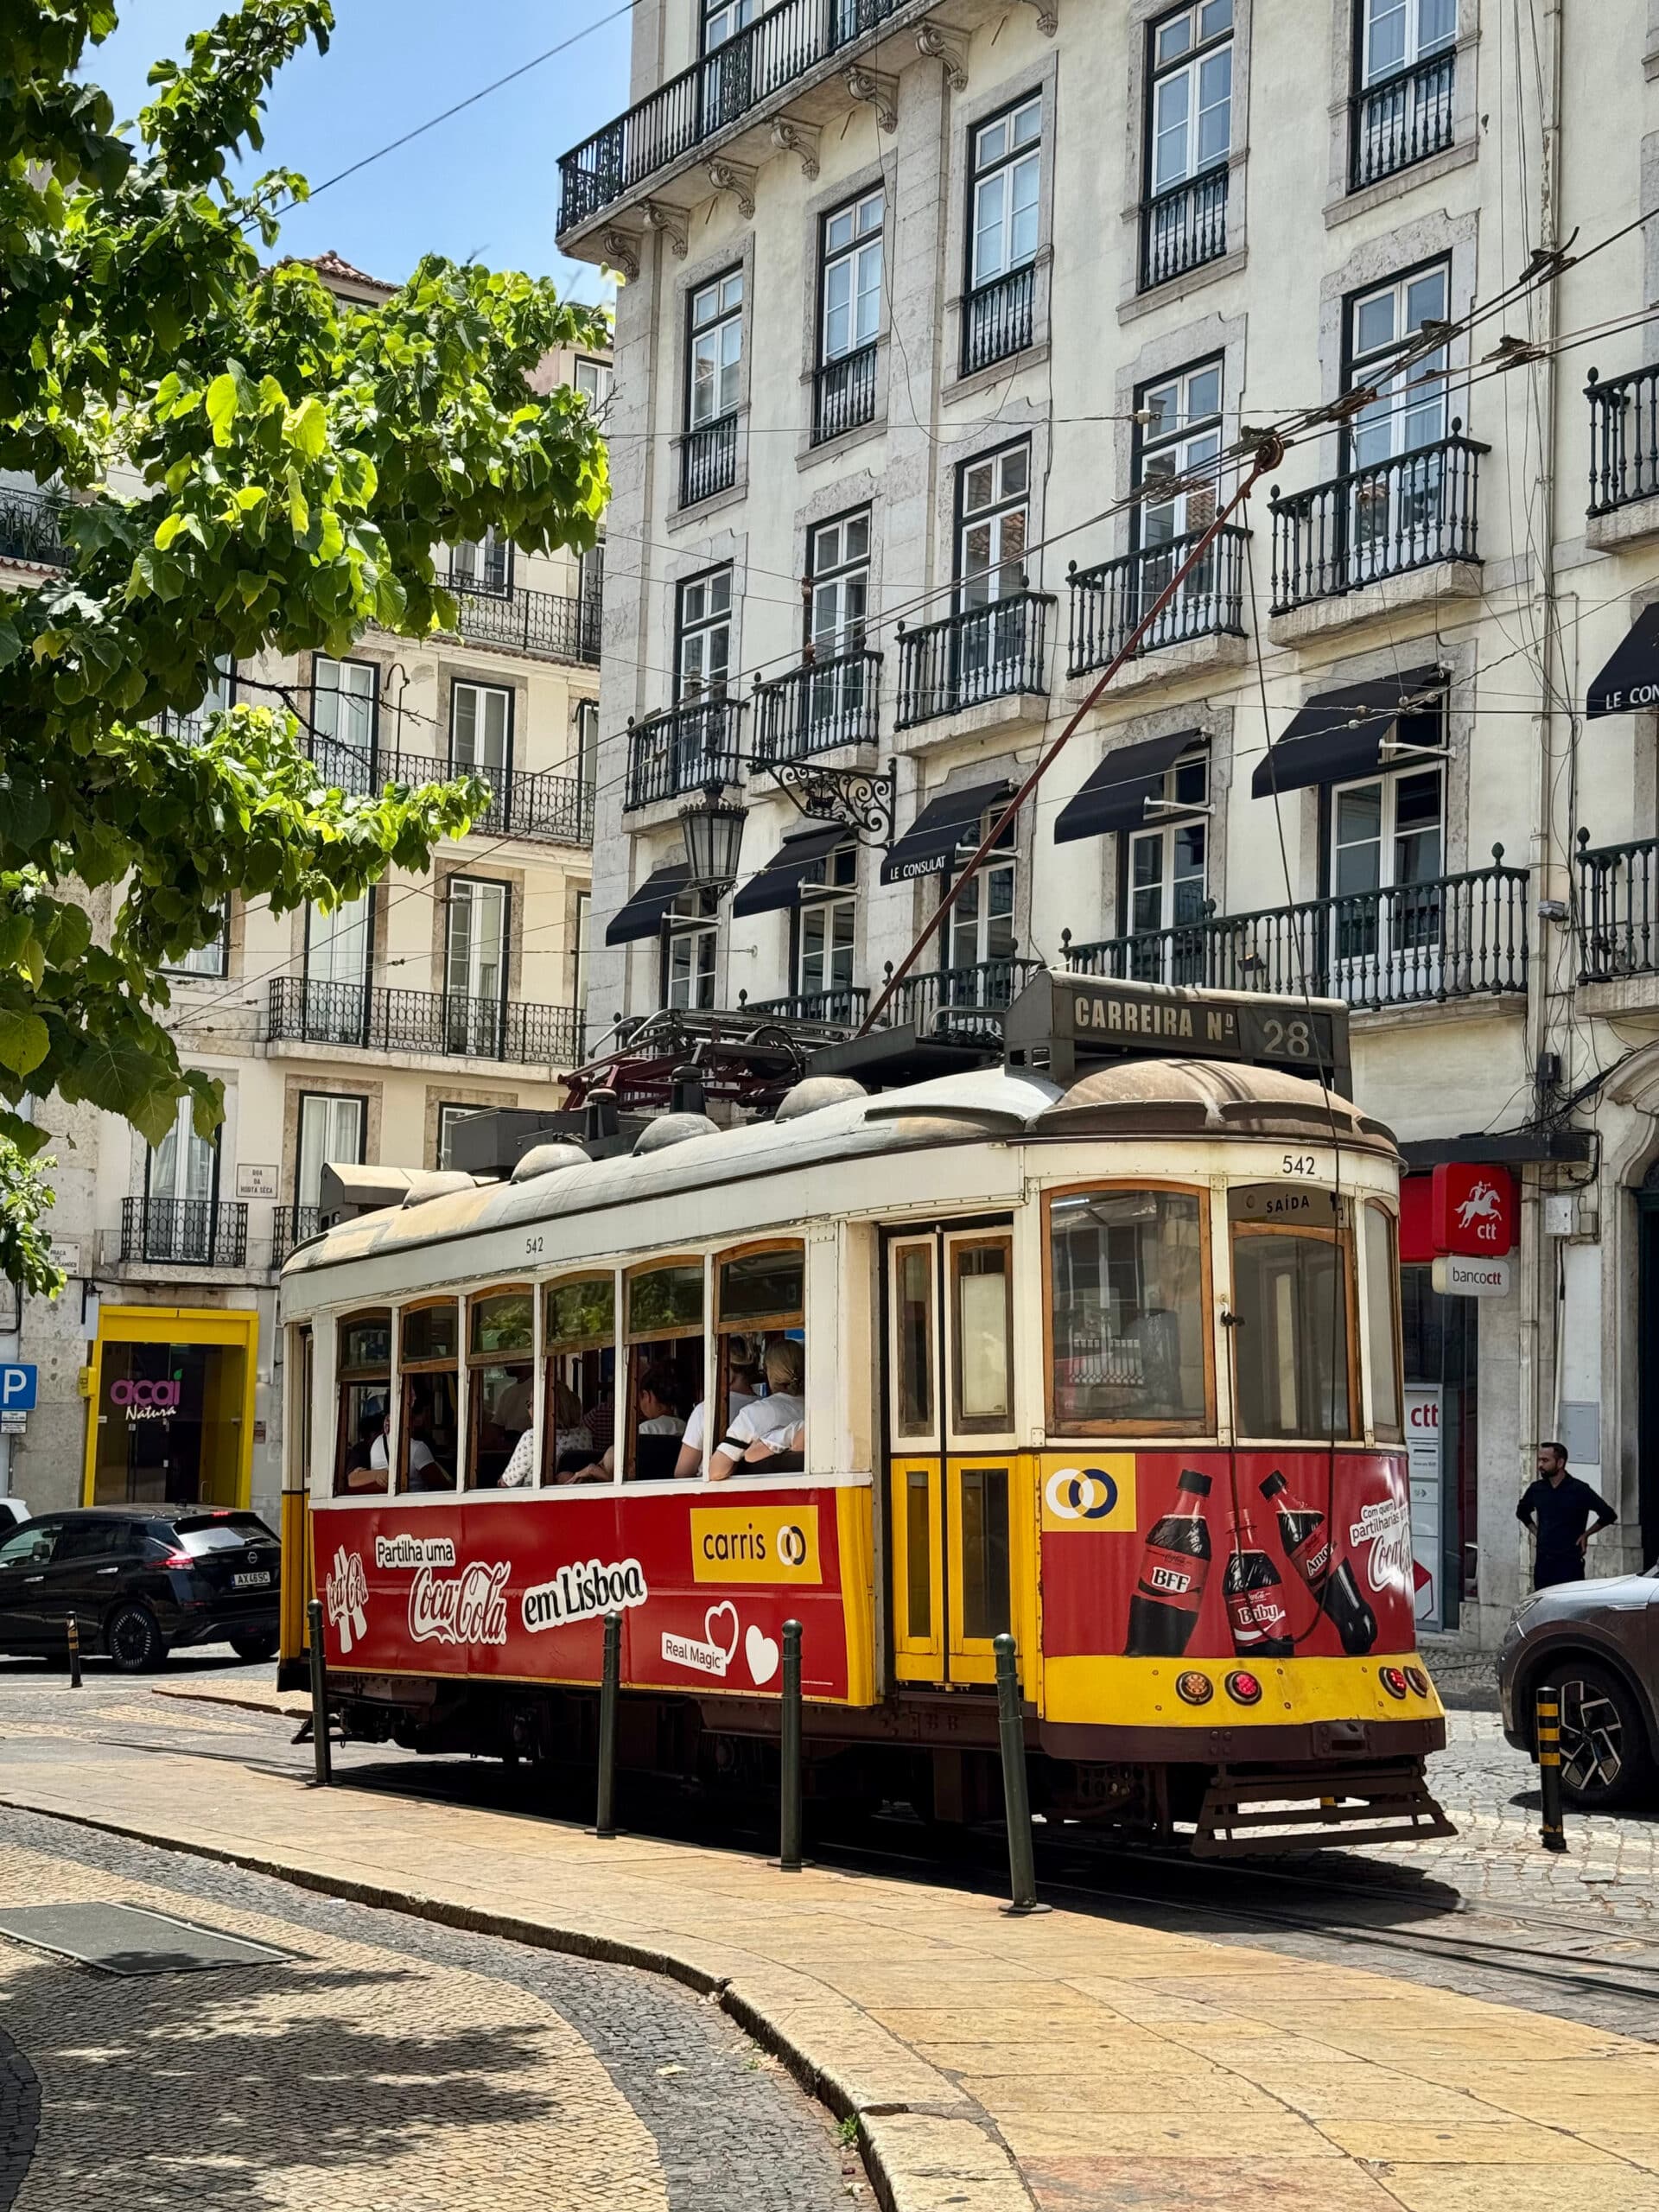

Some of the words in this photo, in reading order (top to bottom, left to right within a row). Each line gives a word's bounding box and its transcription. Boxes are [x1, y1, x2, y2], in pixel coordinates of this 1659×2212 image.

[1605, 691, 1622, 710] LE
[890, 867, 899, 880] LE
[903, 855, 946, 877] CONSULAT
[1075, 996, 1193, 1038] CARREIRA
[1263, 1019, 1309, 1058] 28
[1282, 1154, 1315, 1176] 542
[1267, 1193, 1310, 1213] SAÍDA
[1477, 1223, 1497, 1240] ctt
[526, 1236, 543, 1254] 542
[1452, 1267, 1502, 1286] bancoctt
[3, 1369, 27, 1404] P
[125, 1404, 177, 1421] Natura
[1410, 1403, 1439, 1427] ctt
[1363, 1507, 1379, 1519] Com
[1351, 1510, 1401, 1542] partilharias
[377, 1541, 423, 1564] Partilha
[425, 1544, 454, 1562] uma
[702, 1522, 766, 1560] carris
[1153, 1568, 1190, 1591] BFF
[410, 1564, 512, 1642] Coca-Cola
[524, 1590, 562, 1625] em
[561, 1566, 644, 1615] Lisboa
[665, 1639, 688, 1660] Real
